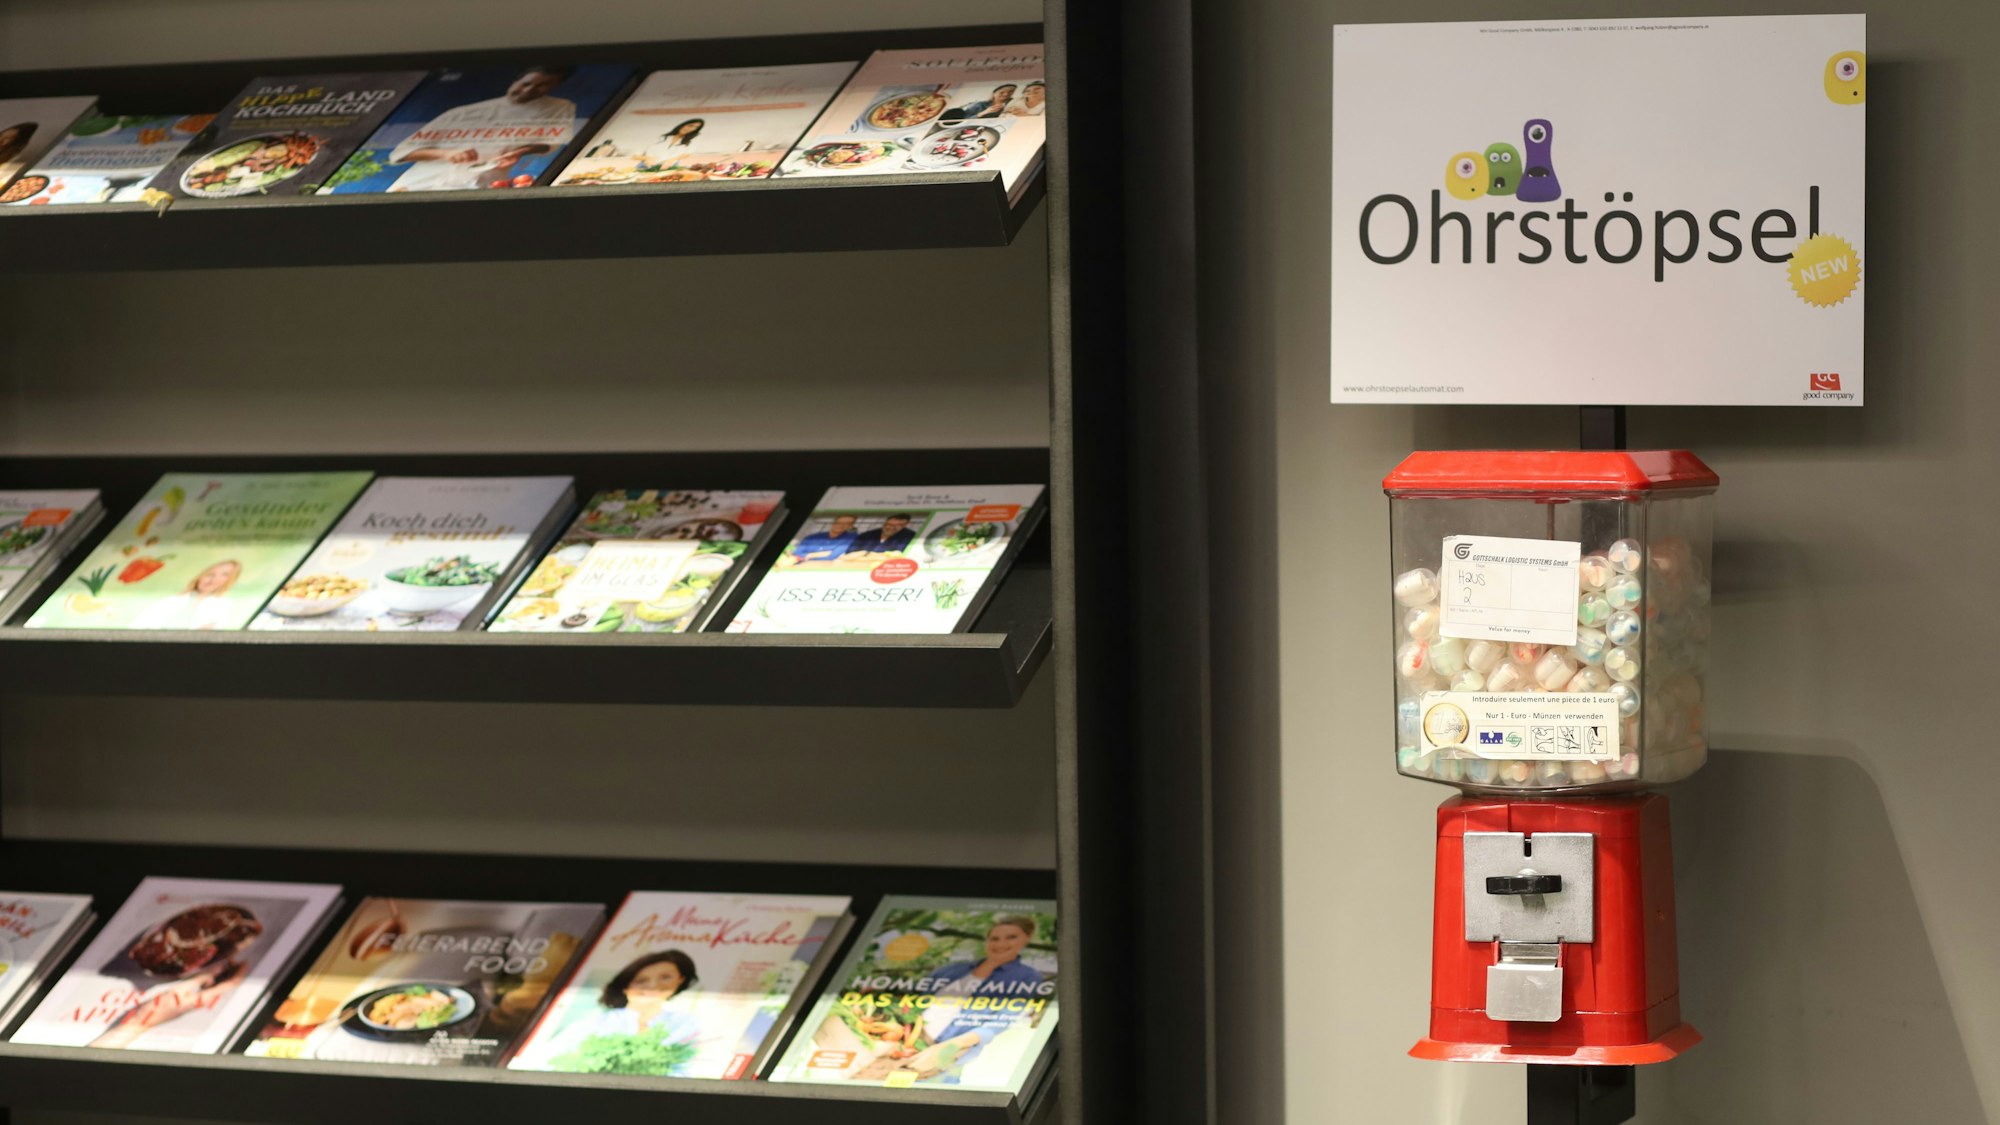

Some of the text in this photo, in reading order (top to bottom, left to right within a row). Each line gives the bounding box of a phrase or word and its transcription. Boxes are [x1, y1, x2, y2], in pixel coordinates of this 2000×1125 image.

[257, 85, 298, 95] DAS
[320, 89, 397, 103] LAND
[233, 102, 377, 118] KOCHBUCH
[411, 126, 566, 141] MEDITERRAN
[1358, 185, 1820, 283] Ohrstöpsel
[1801, 255, 1849, 285] NEW
[1342, 384, 1465, 394] www.ohrstoepselautomat.com
[1802, 391, 1854, 401] good company
[361, 511, 489, 529] Koch dich
[1472, 554, 1569, 567] GOTTSCHALK LOGISTIC SYSTEMS GmbH
[608, 573, 659, 587] GLAS
[776, 588, 924, 602] ISS BESSER!
[1463, 587, 1472, 605] 2
[1472, 696, 1507, 704] Introduire
[1508, 696, 1546, 704] seulement
[1581, 696, 1591, 704] de
[1485, 712, 1499, 720] Nur
[1533, 712, 1561, 720] Münzen
[375, 932, 549, 955] FEIERABEND
[463, 955, 548, 974] FOOD
[851, 975, 1056, 995] HOMEFARMING
[841, 992, 1047, 1013] DAS KOCHBUCH
